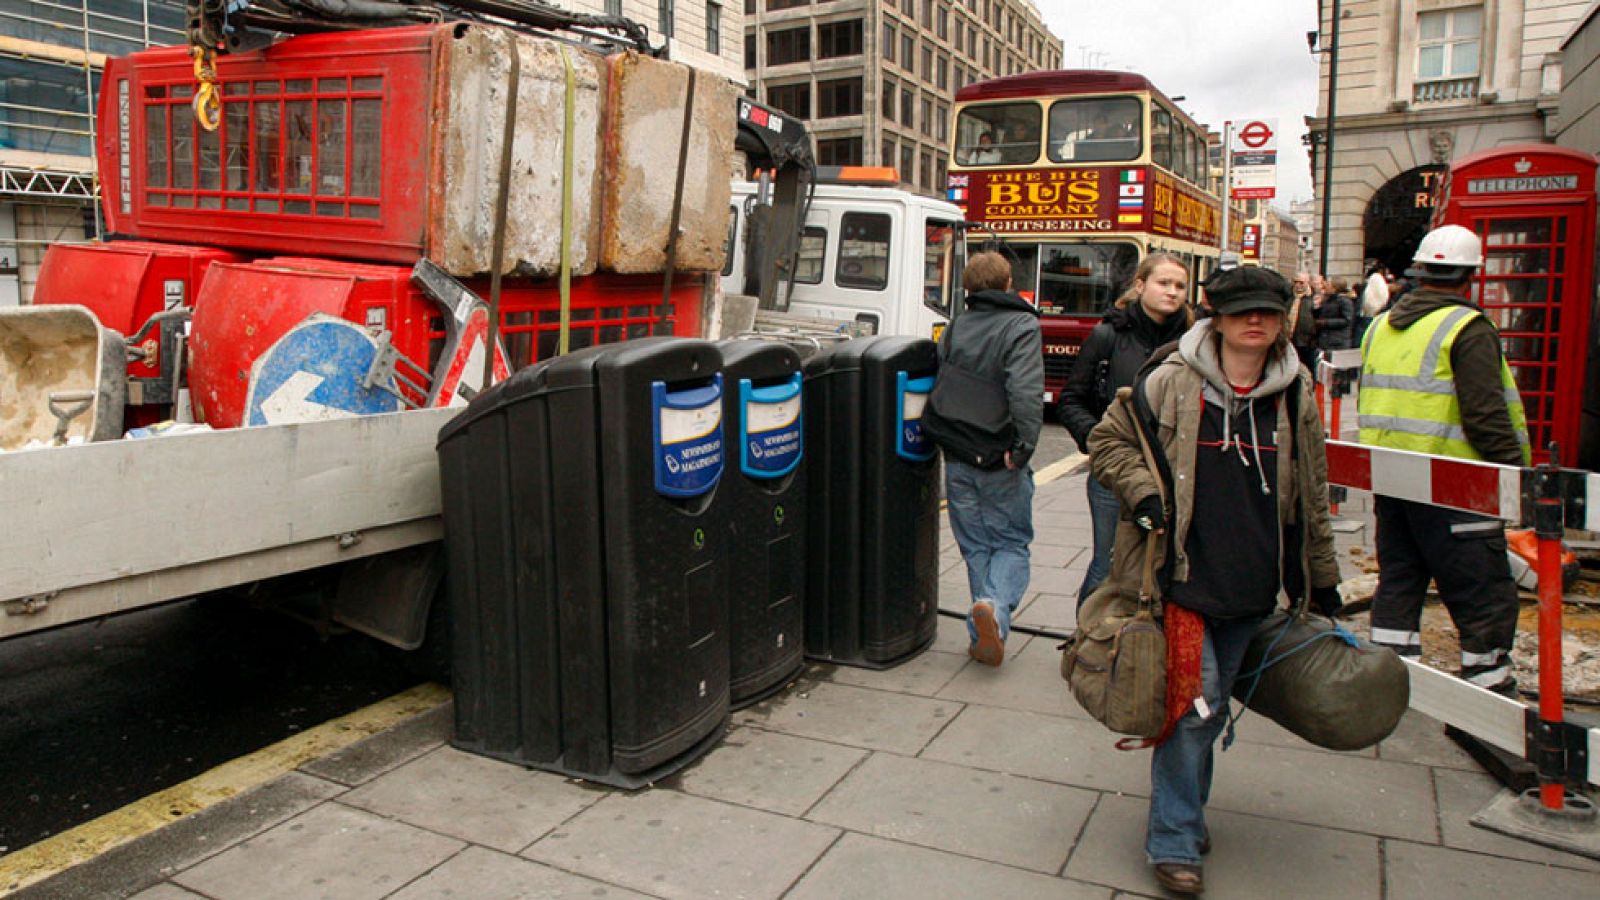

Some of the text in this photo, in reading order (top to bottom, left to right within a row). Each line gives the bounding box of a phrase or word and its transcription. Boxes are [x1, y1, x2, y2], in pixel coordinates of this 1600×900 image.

[988, 170, 1100, 181] THE BIG
[1475, 176, 1574, 192] TELEPHONE
[986, 181, 1100, 204] BUS
[985, 203, 1098, 215] COMPANY
[1045, 344, 1080, 355] TOU
